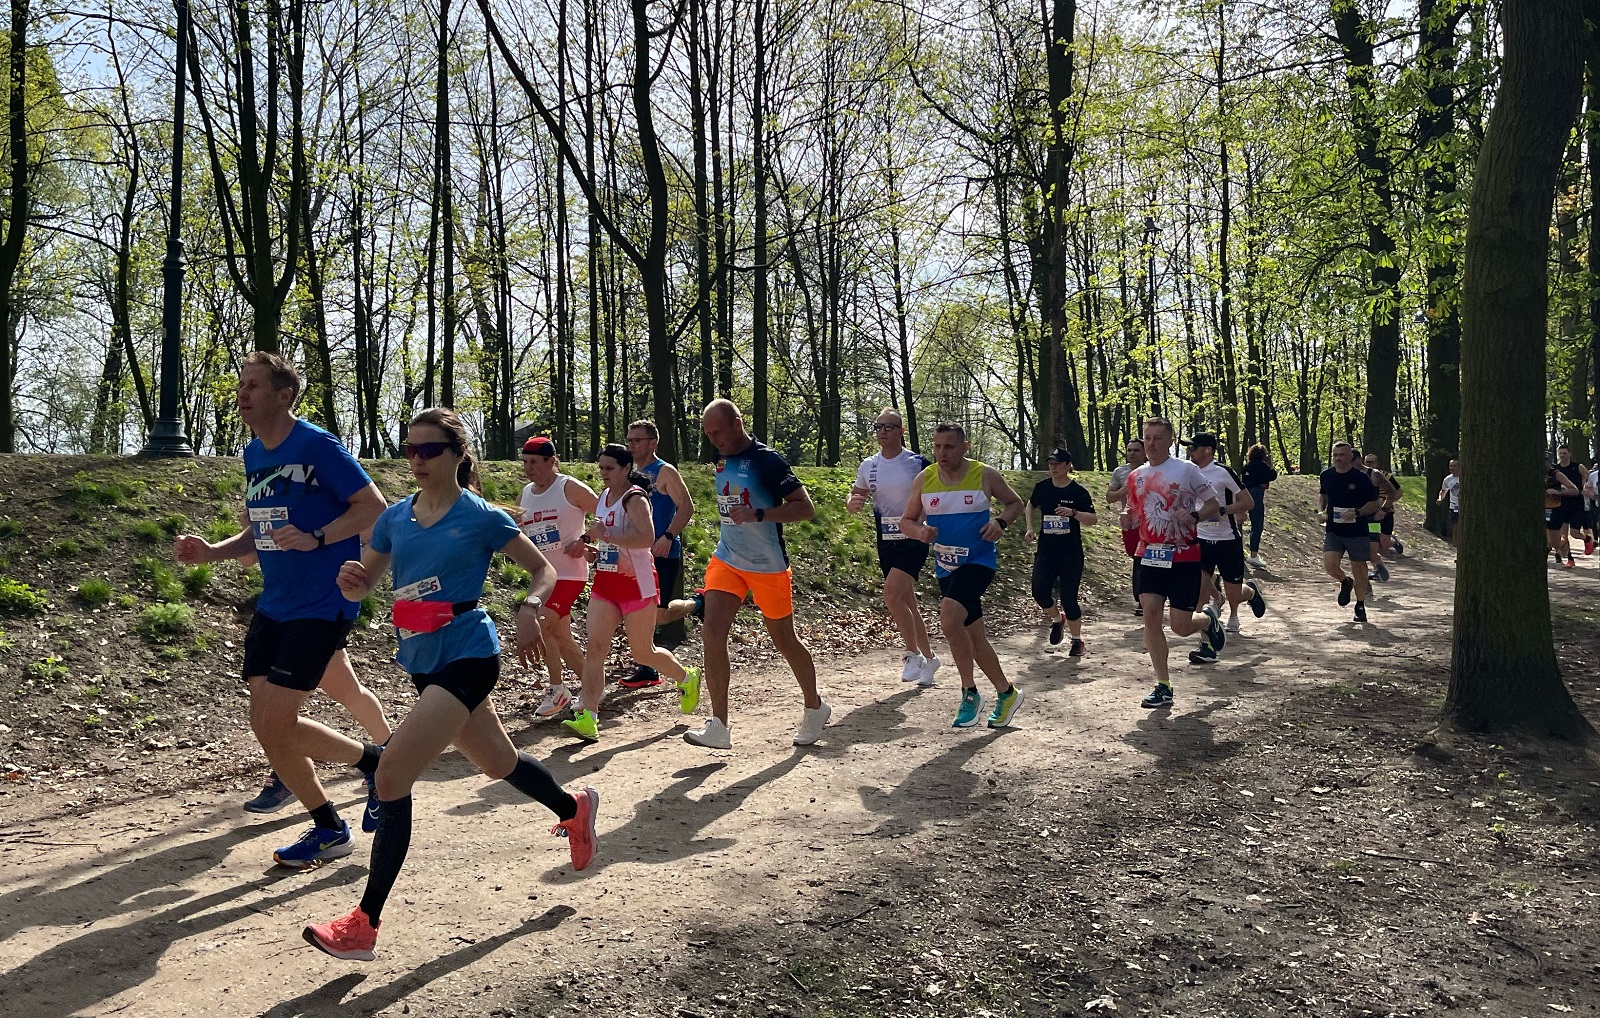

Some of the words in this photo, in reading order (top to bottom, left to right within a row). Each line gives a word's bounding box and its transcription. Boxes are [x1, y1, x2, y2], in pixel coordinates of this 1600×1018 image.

[280, 510, 286, 519] 5
[535, 533, 549, 543] 93
[599, 551, 609, 561] 94
[940, 553, 959, 564] 231
[1151, 550, 1165, 558] 115
[430, 580, 438, 592] 5
